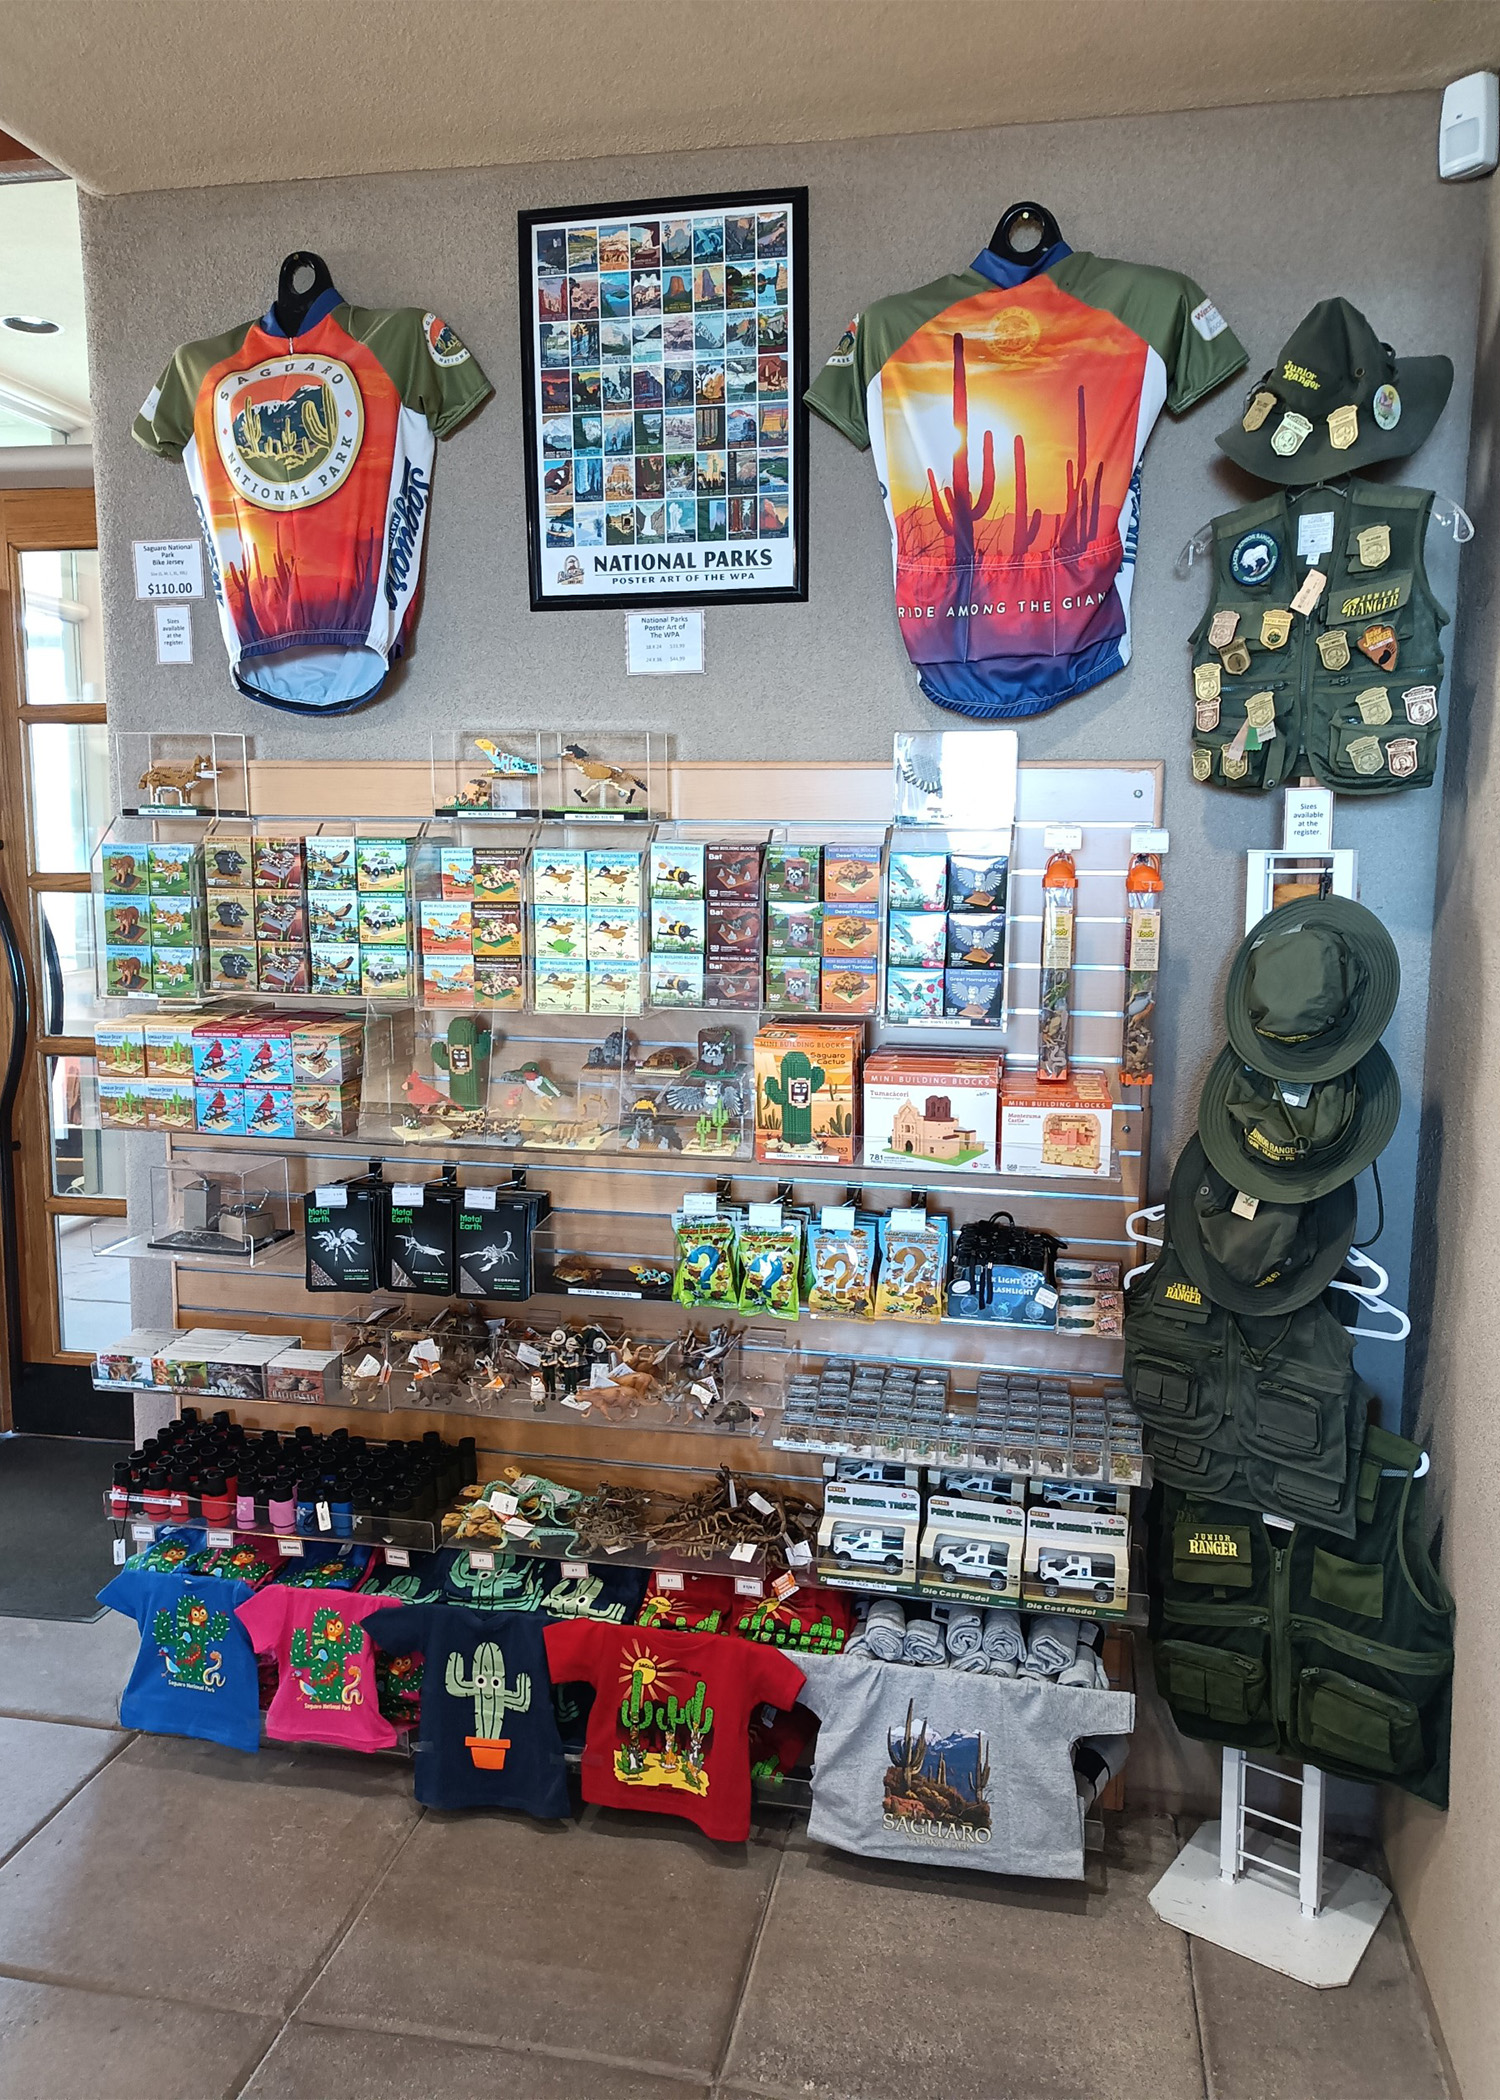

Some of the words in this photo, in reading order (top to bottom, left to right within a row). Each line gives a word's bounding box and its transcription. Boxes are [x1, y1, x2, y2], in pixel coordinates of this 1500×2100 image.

[1284, 360, 1318, 381] Junior
[220, 362, 344, 401] SAGUARO
[1282, 370, 1321, 391] Ranger
[228, 452, 310, 501] NATIONAL
[318, 436, 353, 487] PARK
[168, 543, 193, 551] National
[166, 558, 184, 566] Jersey
[594, 552, 697, 573] NATIONAL
[704, 548, 773, 568] PARKS
[612, 575, 656, 585] POSTER
[660, 574, 682, 584] ART
[686, 574, 700, 583] OF
[704, 573, 726, 582] THE
[730, 572, 755, 581] WPA
[148, 583, 193, 595] $110.00
[1360, 587, 1400, 602] JUNIOR
[898, 606, 935, 618] RIDE
[946, 602, 1007, 617] AMONG
[1018, 601, 1052, 613] THE
[1346, 594, 1399, 617] RANGER
[664, 631, 680, 639] WPA
[1294, 811, 1324, 819] available
[1294, 829, 1322, 837] register.
[899, 1076, 947, 1084] BUILDING
[952, 1078, 990, 1086] BLOCKS
[392, 1208, 413, 1216] Metal
[460, 1214, 483, 1223] Metal
[998, 1276, 1020, 1285] LIGHT
[1172, 1282, 1199, 1293] JUNIOR
[1165, 1287, 1202, 1305] RANGER
[828, 1495, 851, 1504] PARK
[852, 1498, 887, 1509] RANGER
[888, 1501, 918, 1511] TRUCK
[931, 1508, 955, 1518] PARK
[956, 1511, 991, 1523] RANGER
[993, 1516, 1023, 1527] TRUCK
[1030, 1520, 1055, 1530] PARK
[1056, 1523, 1092, 1534] RANGER
[1094, 1526, 1126, 1537] TRUCK
[1194, 1533, 1231, 1542] JUNIOR
[1189, 1540, 1238, 1557] RANGER
[922, 1587, 938, 1595] Die
[939, 1590, 960, 1598] Cast
[961, 1594, 990, 1602] Model
[1067, 1608, 1096, 1616] Model
[168, 1680, 186, 1688] Saguaro
[186, 1682, 205, 1691] National
[882, 1812, 992, 1843] SAGUARO
